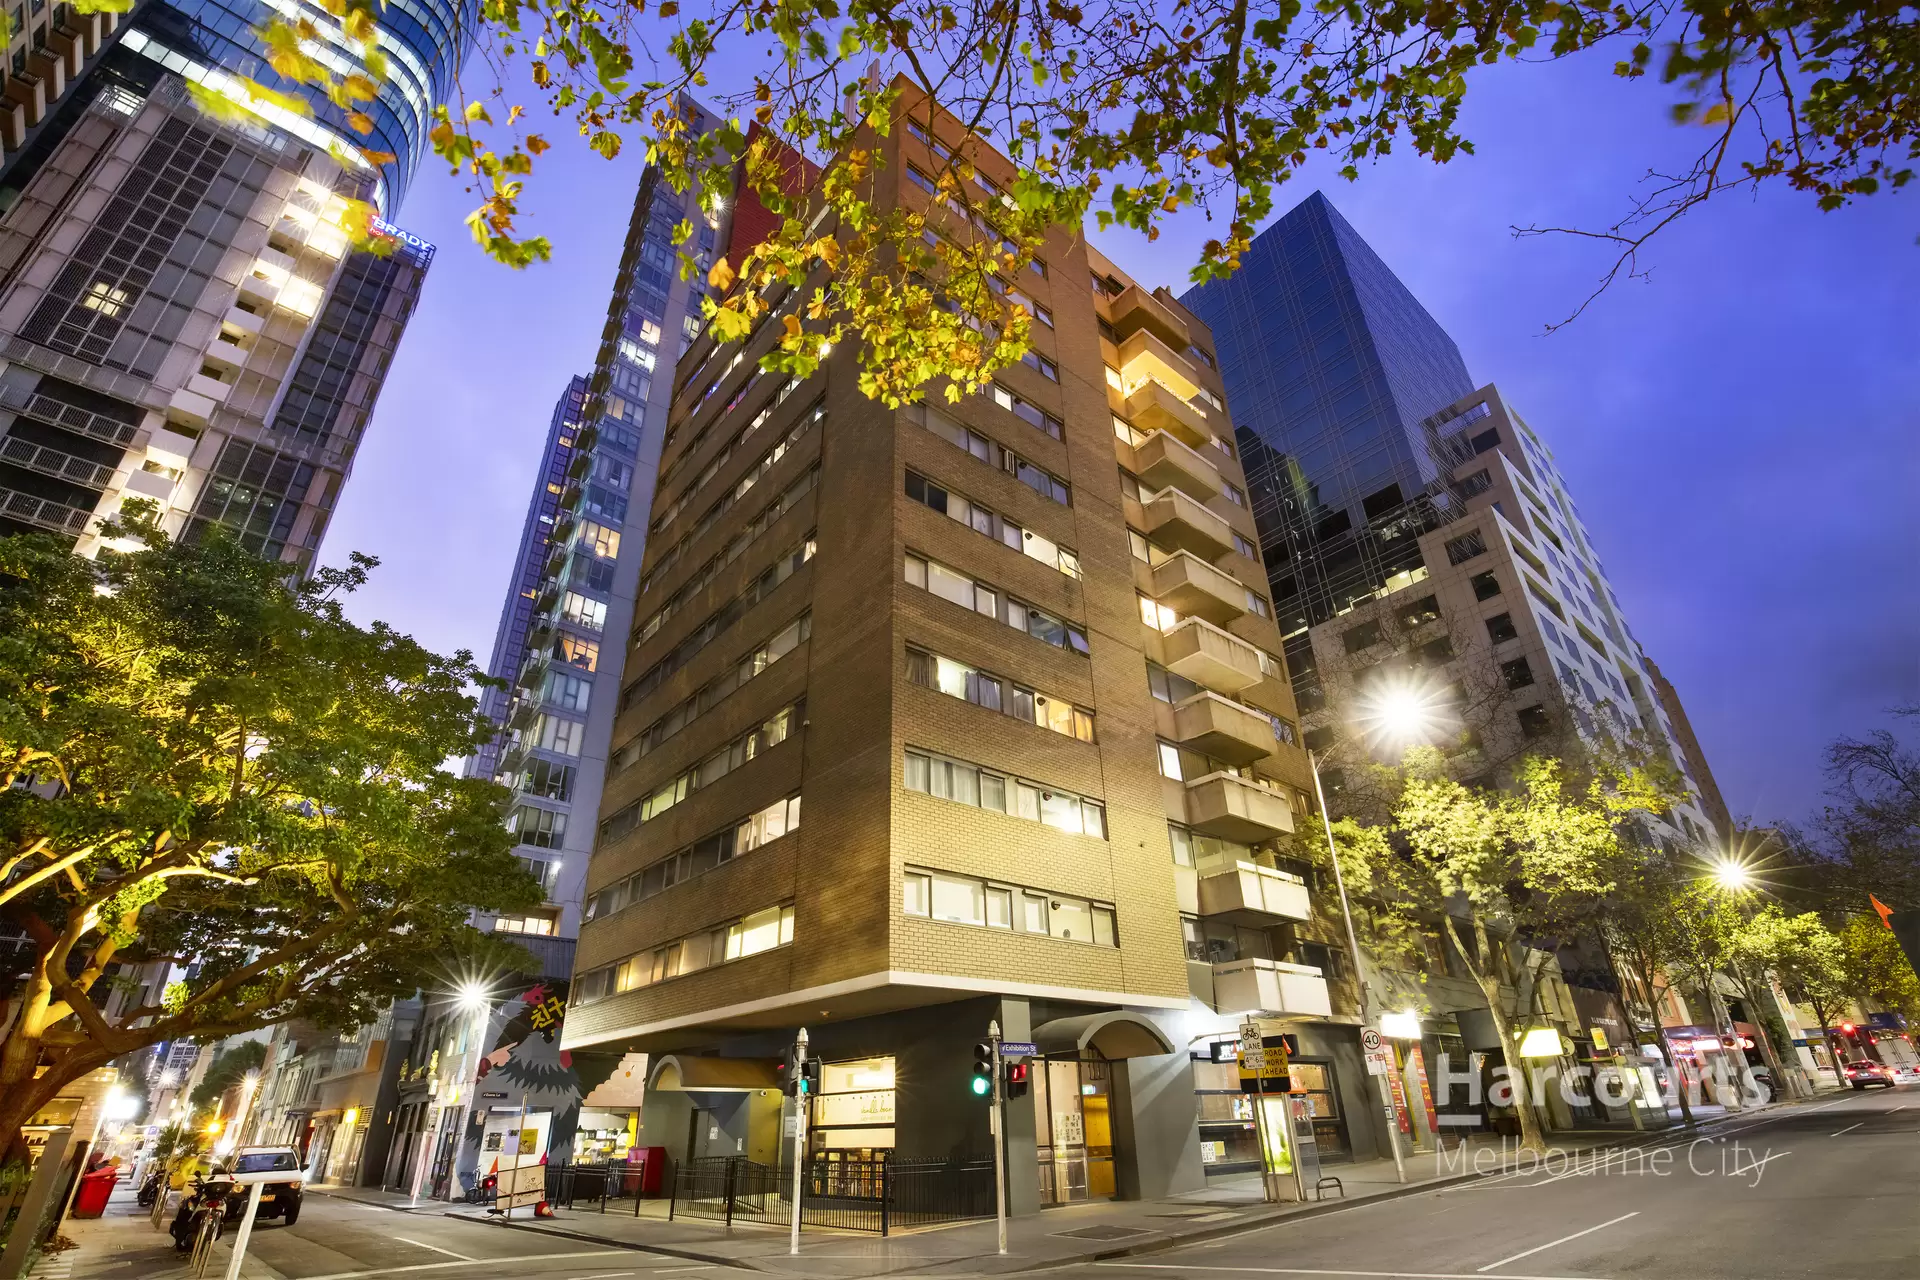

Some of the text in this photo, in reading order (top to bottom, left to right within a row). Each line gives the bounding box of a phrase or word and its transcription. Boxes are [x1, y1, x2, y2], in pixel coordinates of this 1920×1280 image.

[374, 219, 431, 251] BRADY
[530, 996, 565, 1030] 친구
[1364, 1034, 1379, 1045] 40
[1005, 1044, 1030, 1052] Exhibition
[1244, 1042, 1262, 1051] LANE
[1265, 1048, 1283, 1057] ROAD
[1266, 1058, 1284, 1066] WORK
[1265, 1067, 1288, 1075] AHEAD
